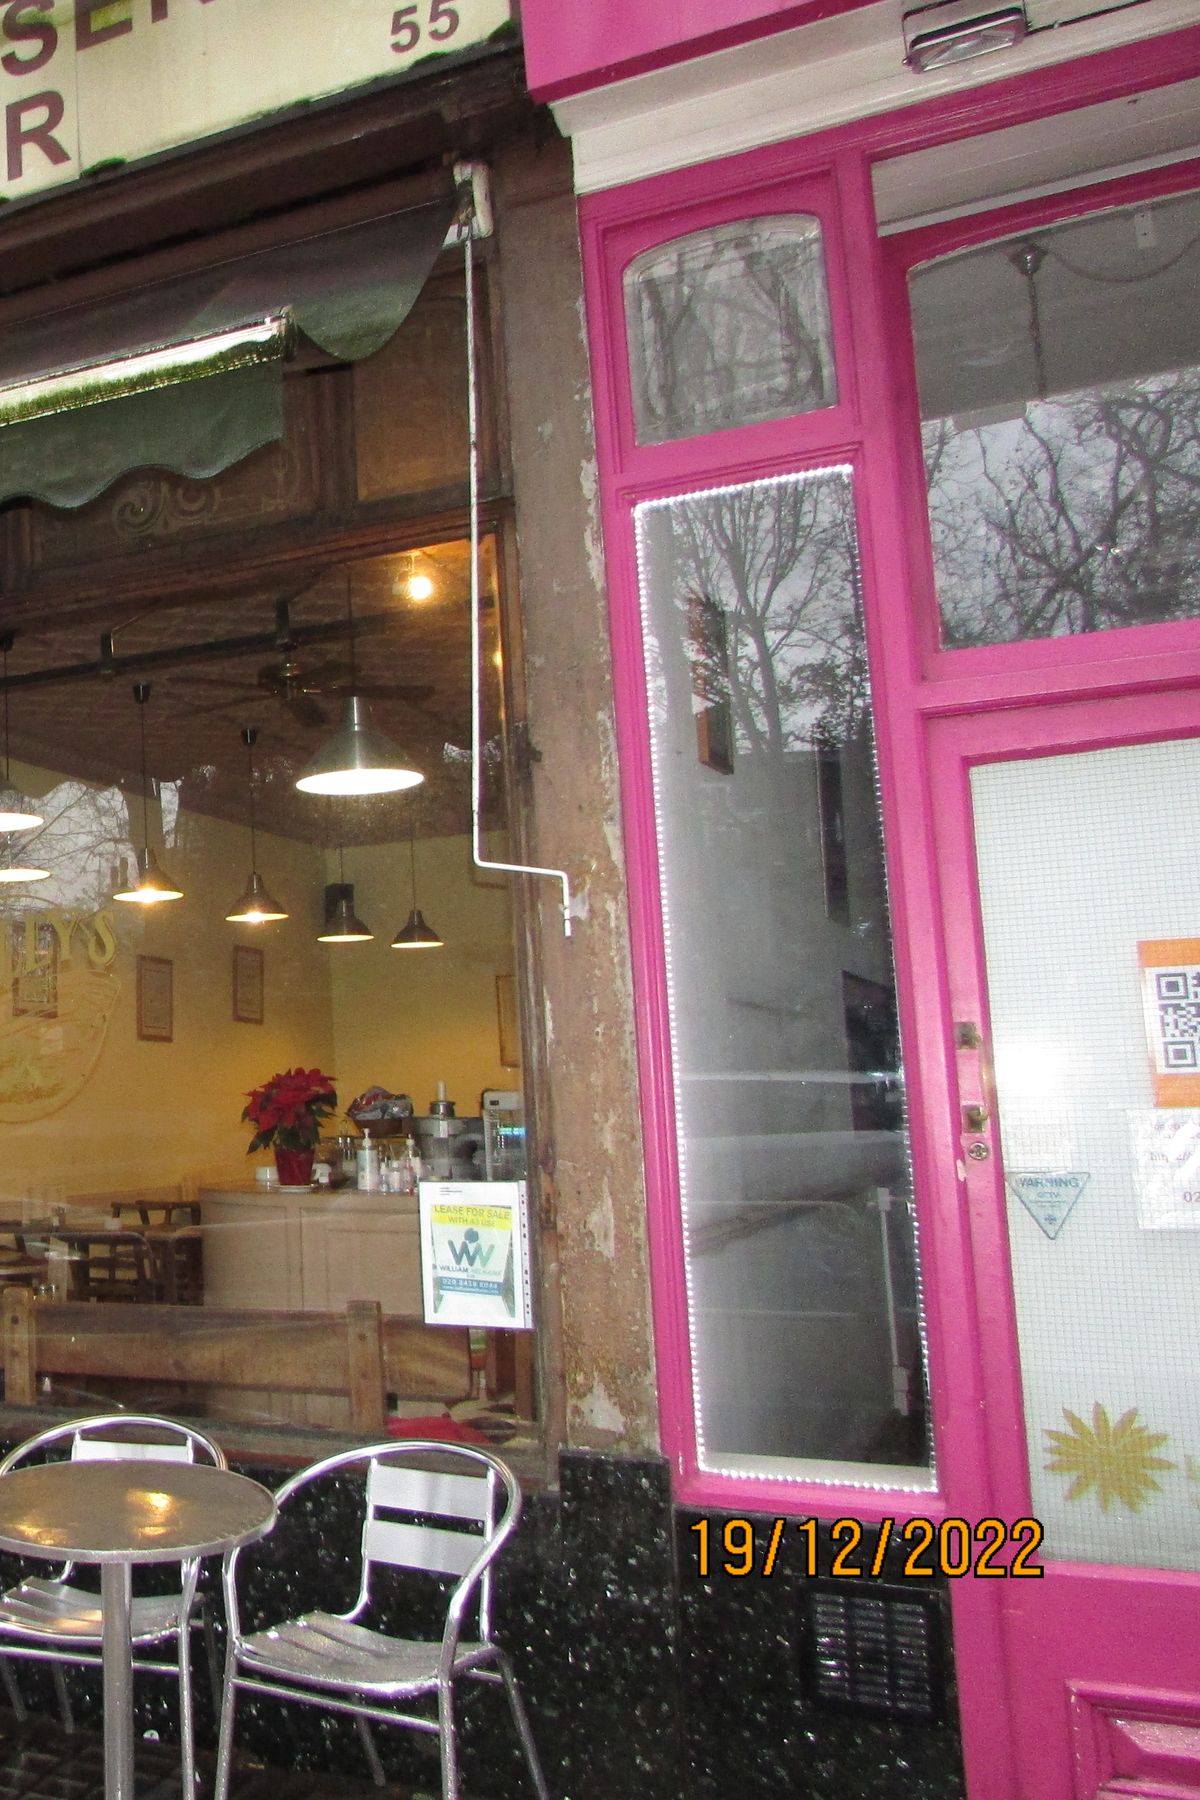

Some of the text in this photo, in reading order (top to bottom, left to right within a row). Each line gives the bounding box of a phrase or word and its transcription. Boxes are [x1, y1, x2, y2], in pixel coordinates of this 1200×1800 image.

[390, 0, 459, 53] 55
[434, 1205, 510, 1220] LEASE FOR SALE
[448, 1216, 468, 1224] WITH
